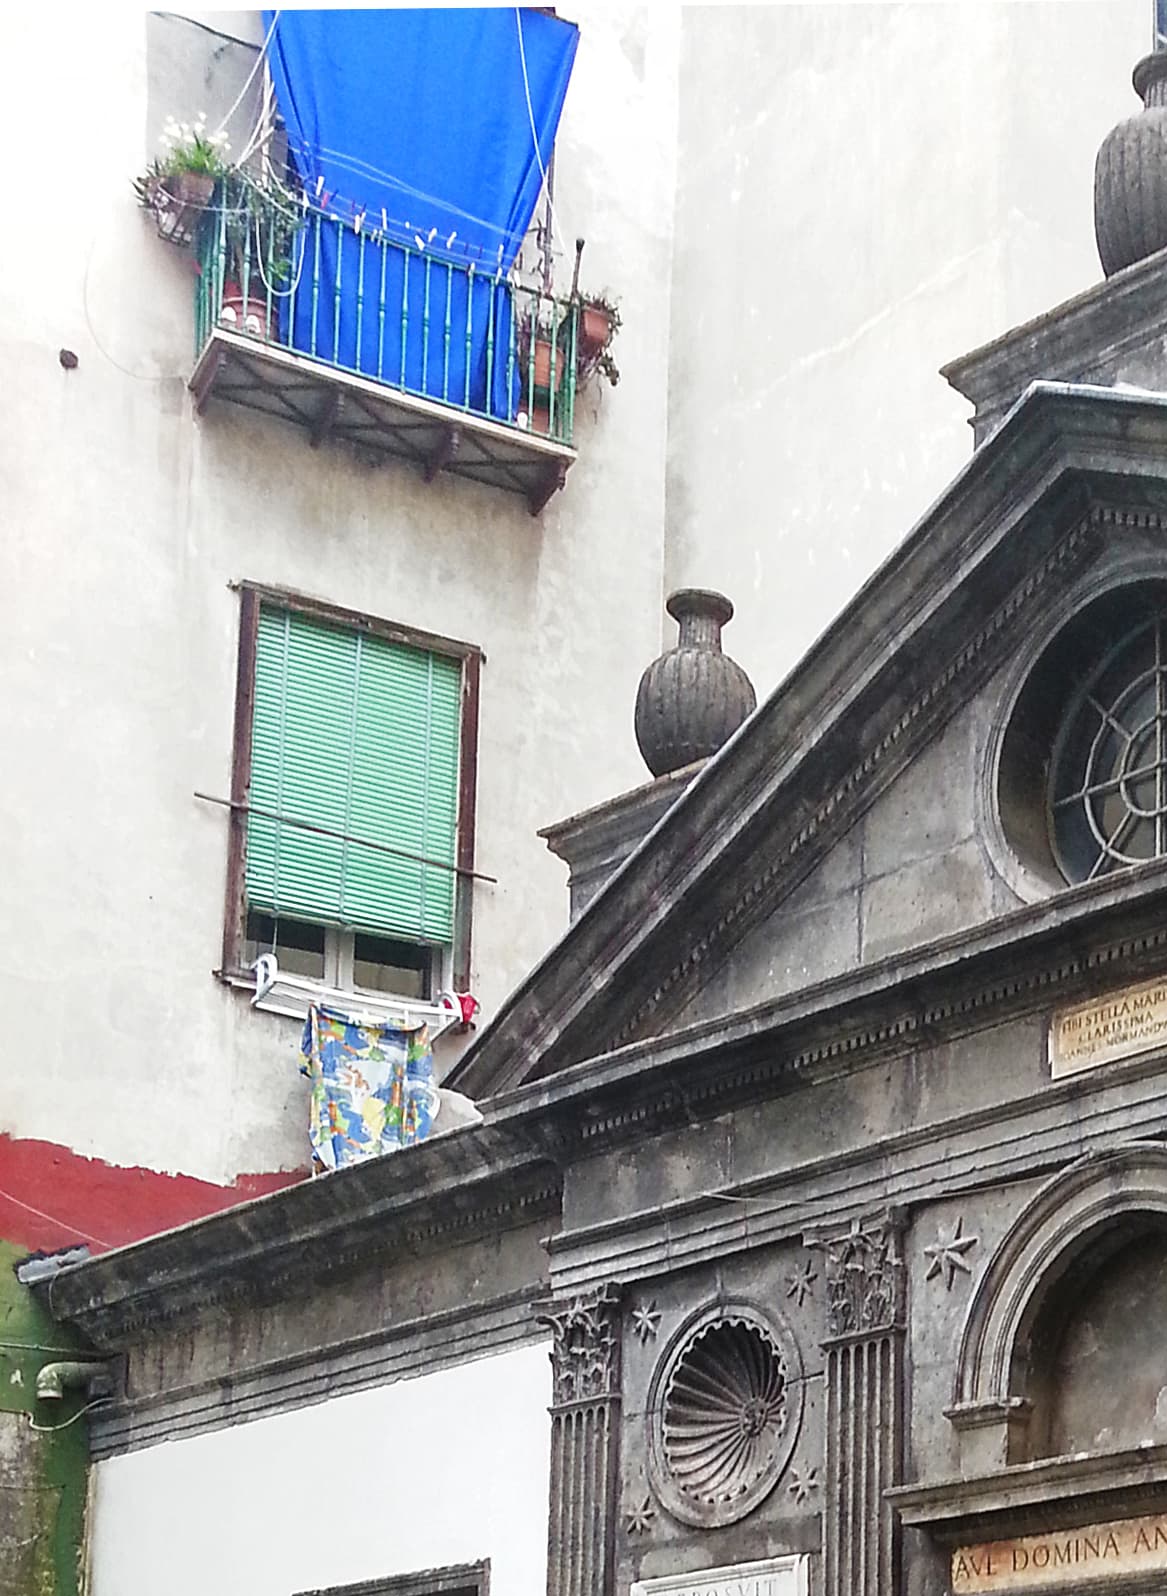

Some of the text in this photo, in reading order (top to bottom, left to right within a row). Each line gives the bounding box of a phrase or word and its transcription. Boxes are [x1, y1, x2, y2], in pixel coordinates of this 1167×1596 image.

[1085, 1001, 1130, 1027] STELLA
[953, 1553, 998, 1582] AVE
[1012, 1532, 1120, 1572] DOMINA
